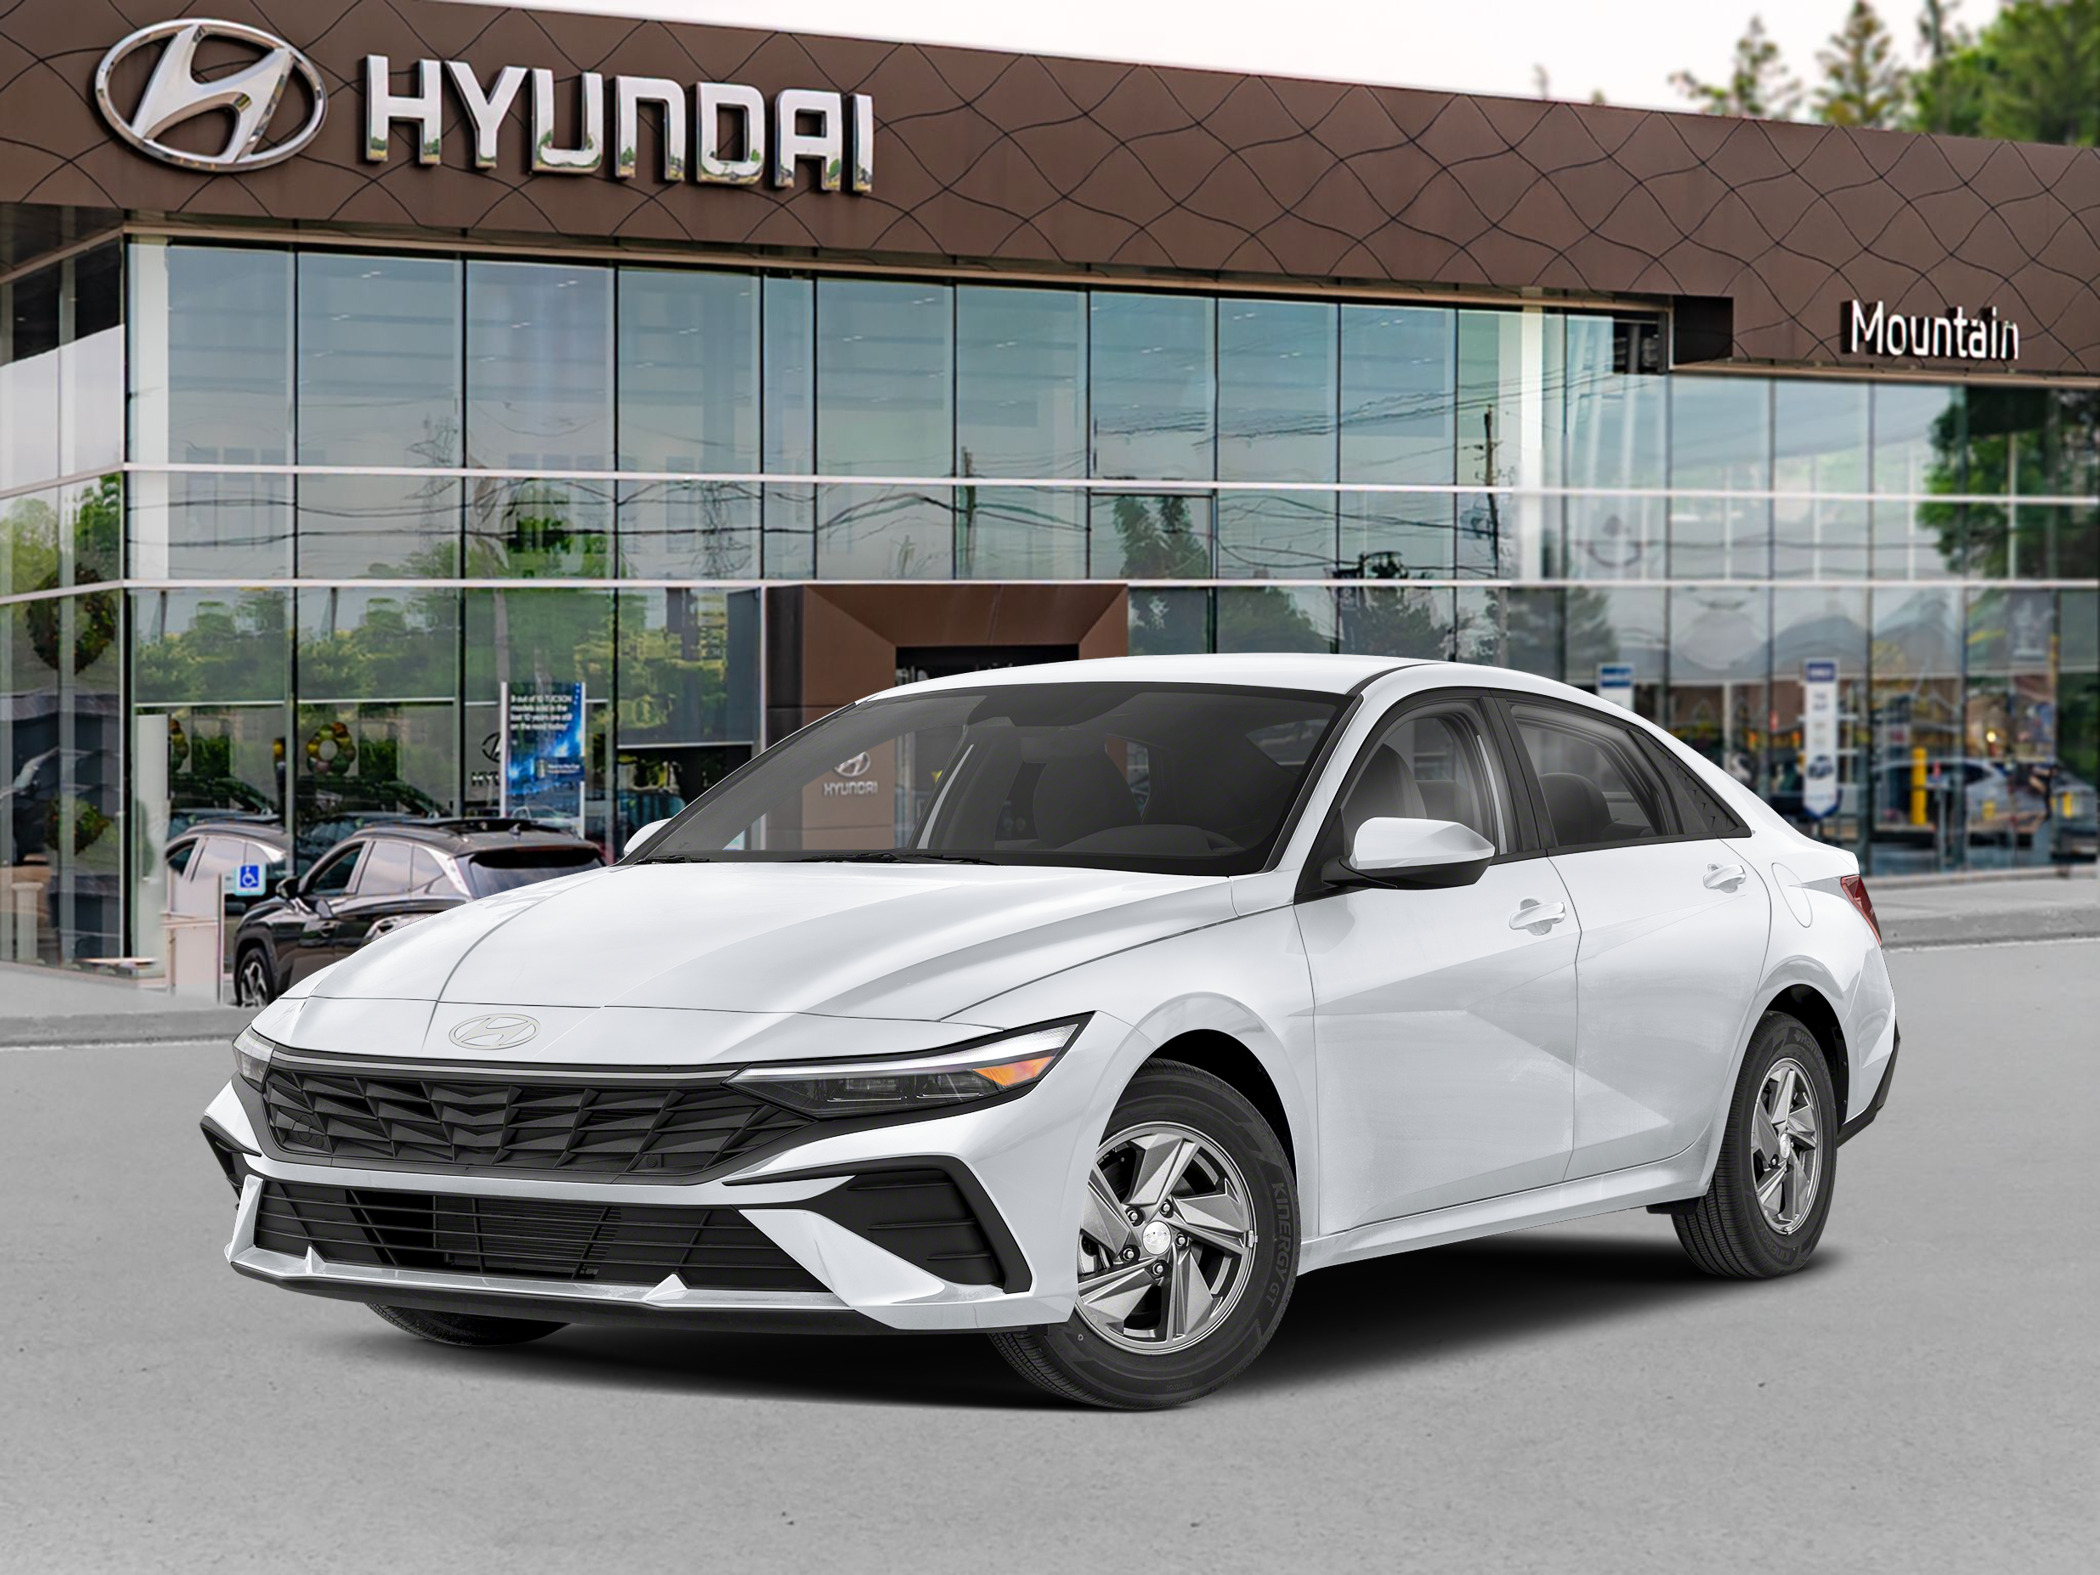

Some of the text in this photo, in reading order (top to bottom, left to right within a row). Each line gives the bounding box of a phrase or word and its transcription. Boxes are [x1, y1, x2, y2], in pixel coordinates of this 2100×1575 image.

[365, 54, 873, 194] HYUNDAI
[1849, 299, 2020, 361] Mountain
[824, 781, 878, 796] HYUNDAI
[1266, 1182, 1292, 1308] KINERGY GT
